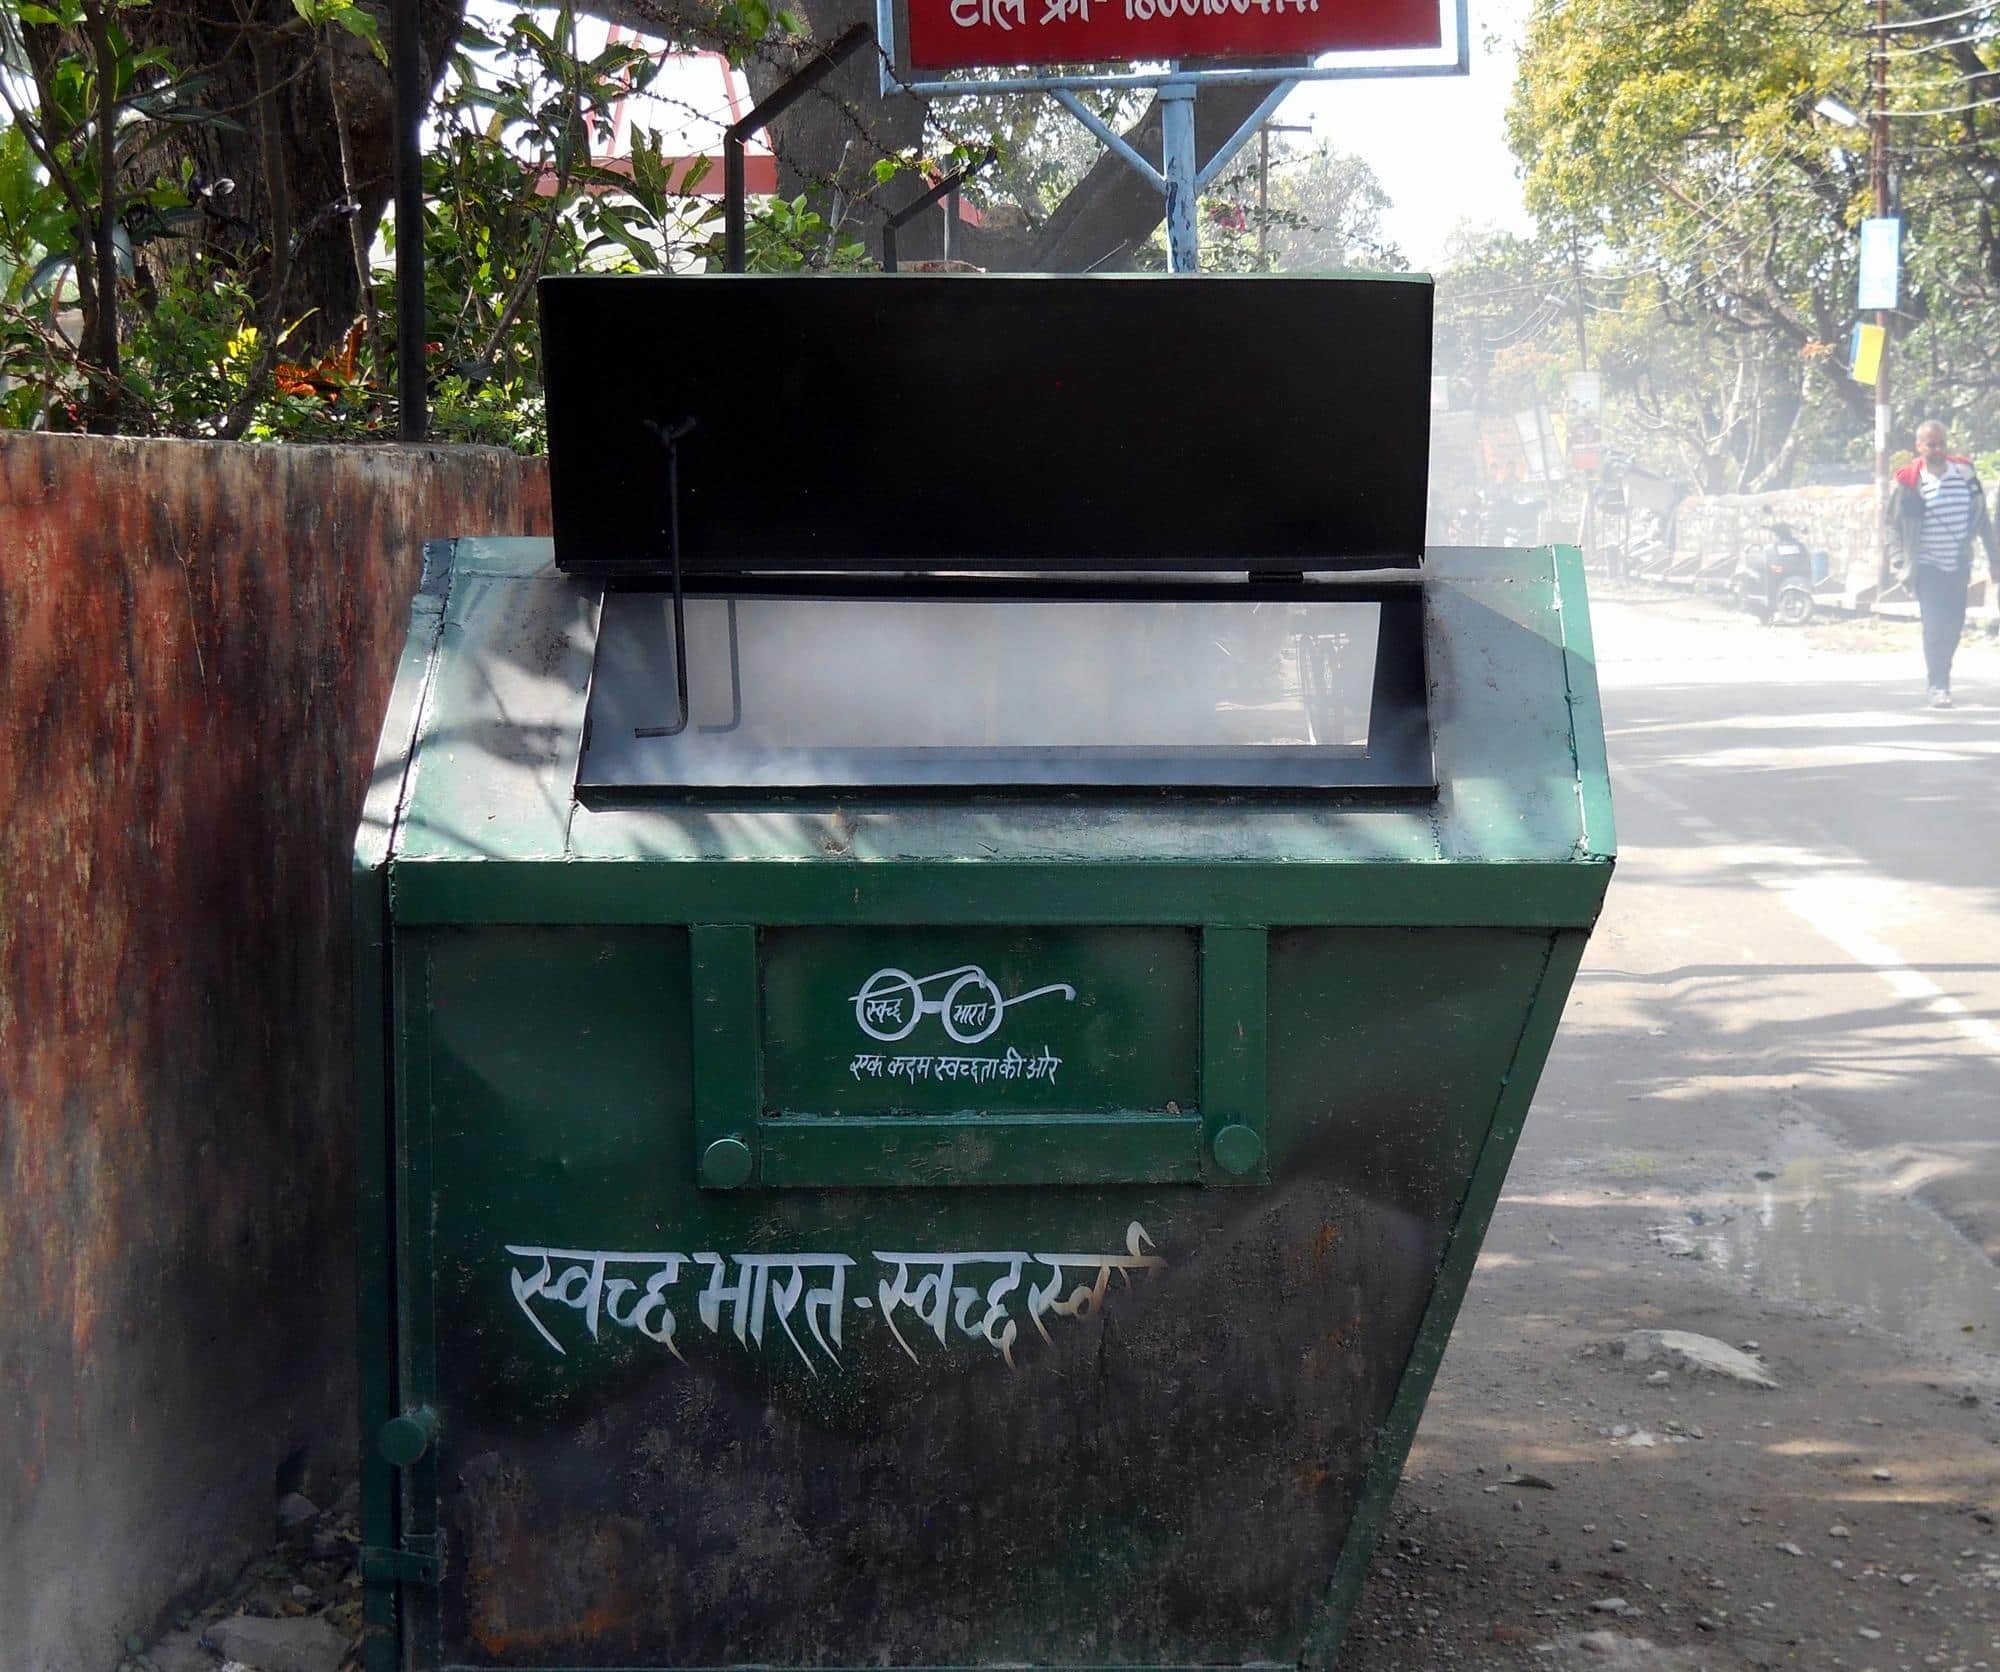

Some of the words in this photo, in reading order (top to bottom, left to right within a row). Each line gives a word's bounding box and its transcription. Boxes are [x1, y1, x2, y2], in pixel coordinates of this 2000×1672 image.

[953, 1002, 988, 1026] भारत
[887, 1056, 934, 1085] कदम
[934, 1056, 999, 1084] स्वच्छता
[999, 1046, 1026, 1080] की
[1026, 1045, 1063, 1086] ओर
[504, 1245, 692, 1366] स्वच्छ
